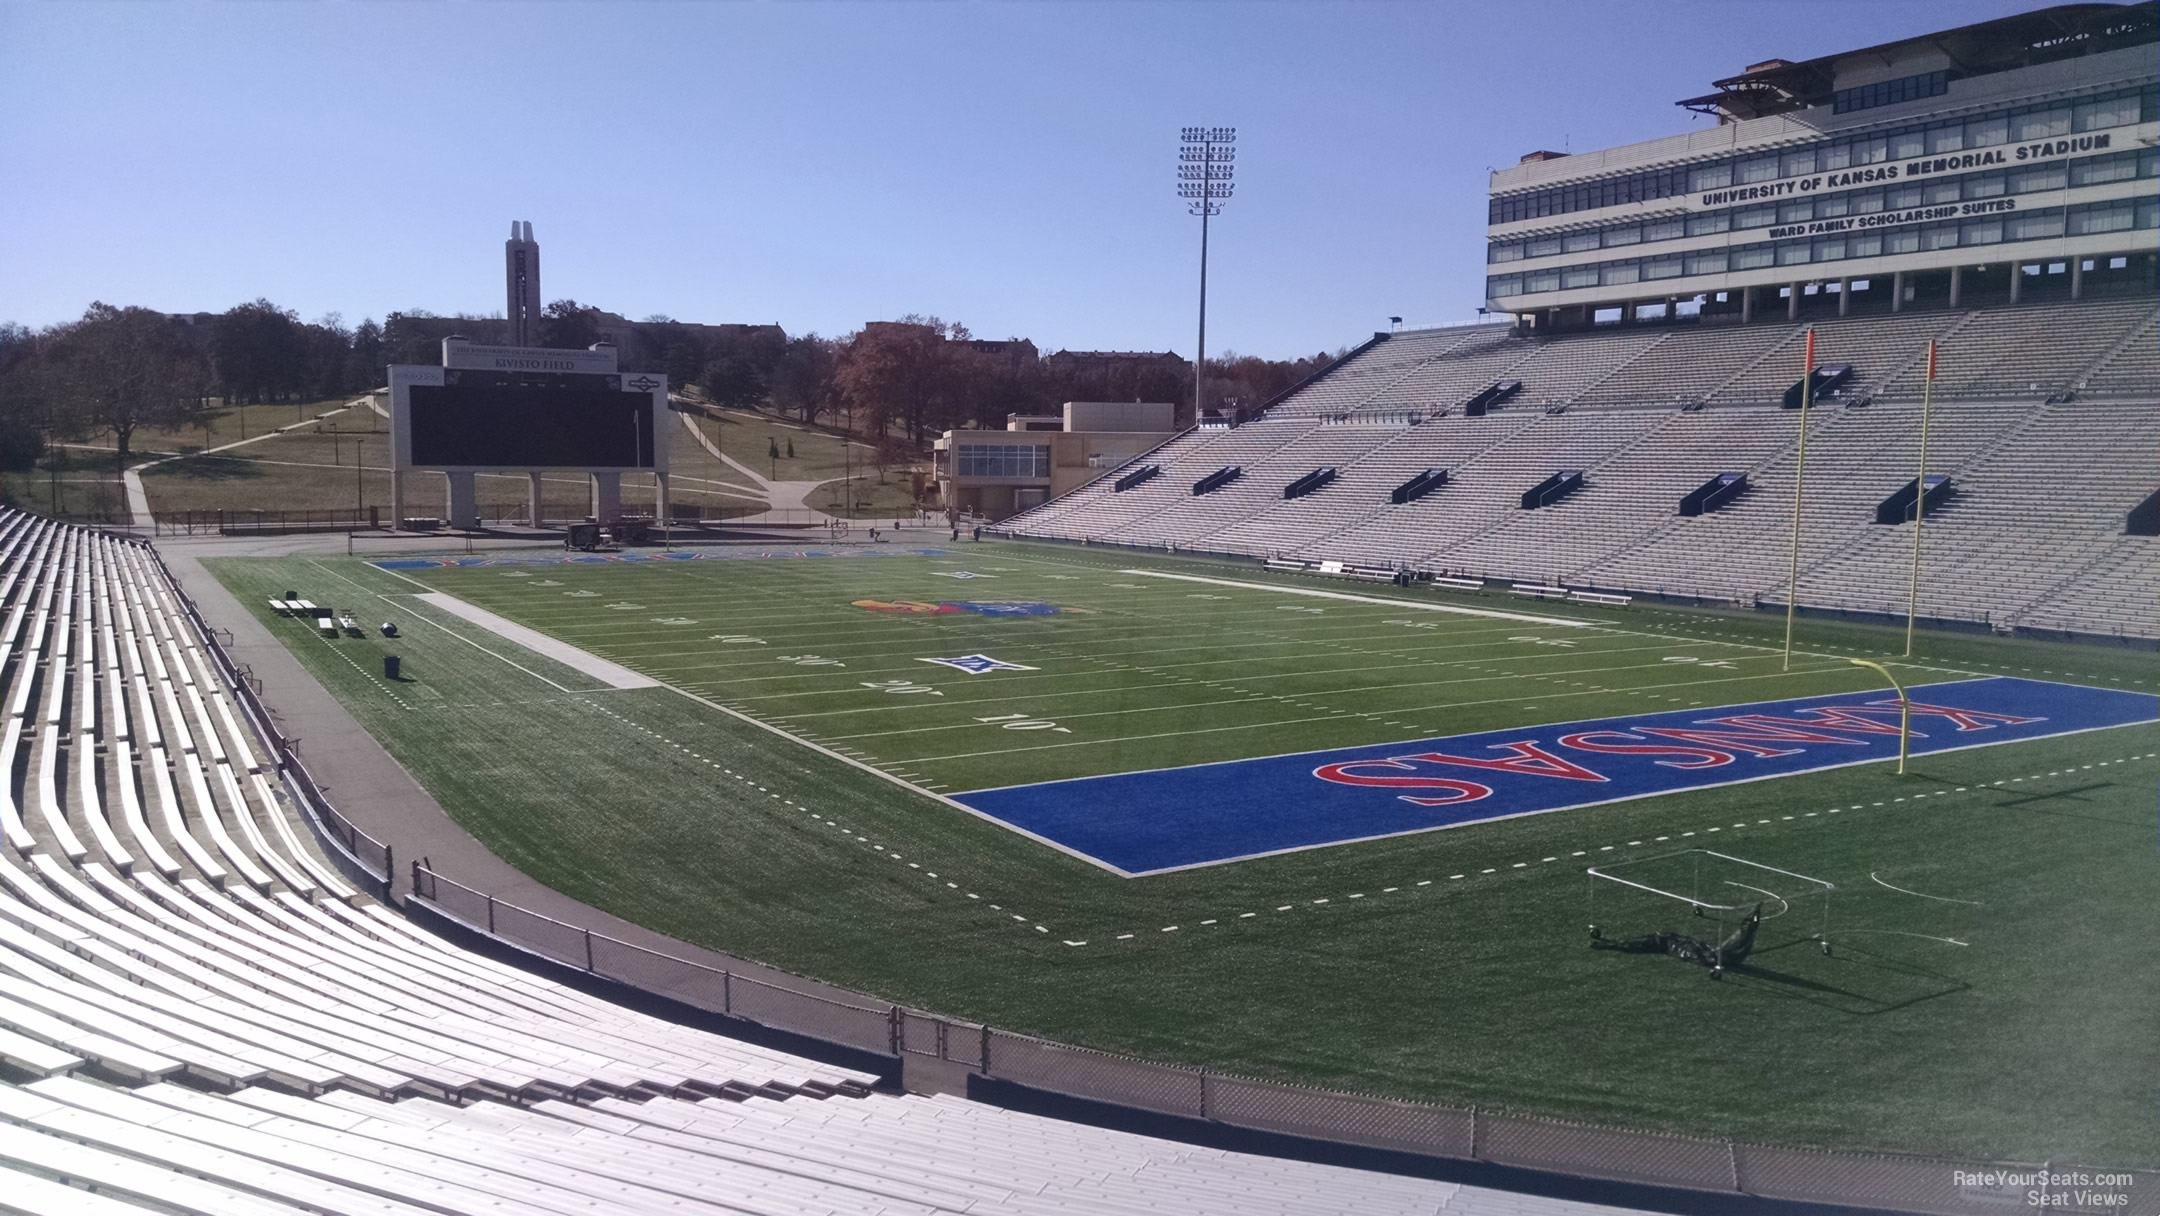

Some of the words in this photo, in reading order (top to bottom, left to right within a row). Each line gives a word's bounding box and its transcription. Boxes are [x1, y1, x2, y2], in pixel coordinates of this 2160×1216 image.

[1703, 181, 1796, 206] UNIVERSITY
[1800, 177, 1822, 191] OF
[1827, 165, 1899, 188] KANSAS
[1906, 150, 2007, 176] MEMORIAL
[2016, 133, 2112, 160] STADIUM
[1768, 225, 1806, 239] WARD
[1808, 219, 1855, 234] FAMILY
[1858, 205, 1958, 227] SCHOLARSHIP
[1961, 198, 2016, 215] SUITES
[495, 358, 540, 369] KIVISTO
[543, 359, 575, 370] FIELD
[1311, 698, 2050, 806] KANSAS
